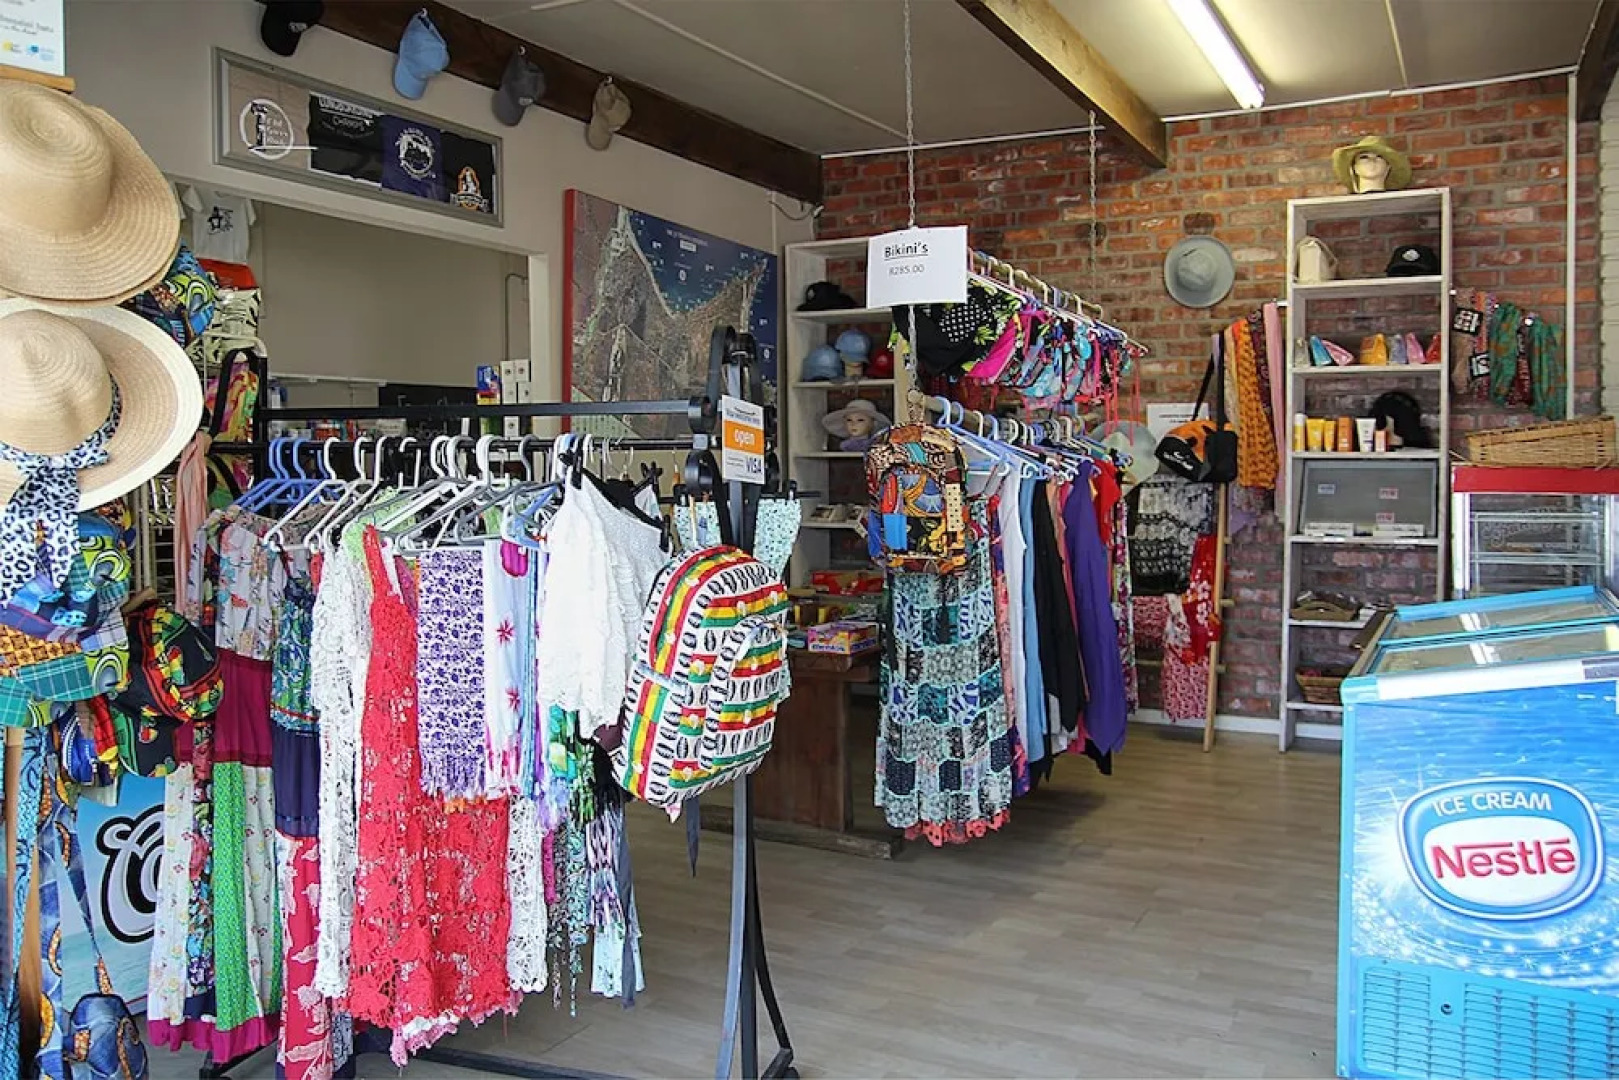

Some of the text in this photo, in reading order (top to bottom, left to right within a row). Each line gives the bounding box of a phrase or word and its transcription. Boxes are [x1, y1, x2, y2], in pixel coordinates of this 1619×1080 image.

[885, 241, 929, 258] Bikini's
[733, 428, 756, 448] open
[746, 456, 763, 474] VISA
[1432, 791, 1552, 816] ICE CREAM
